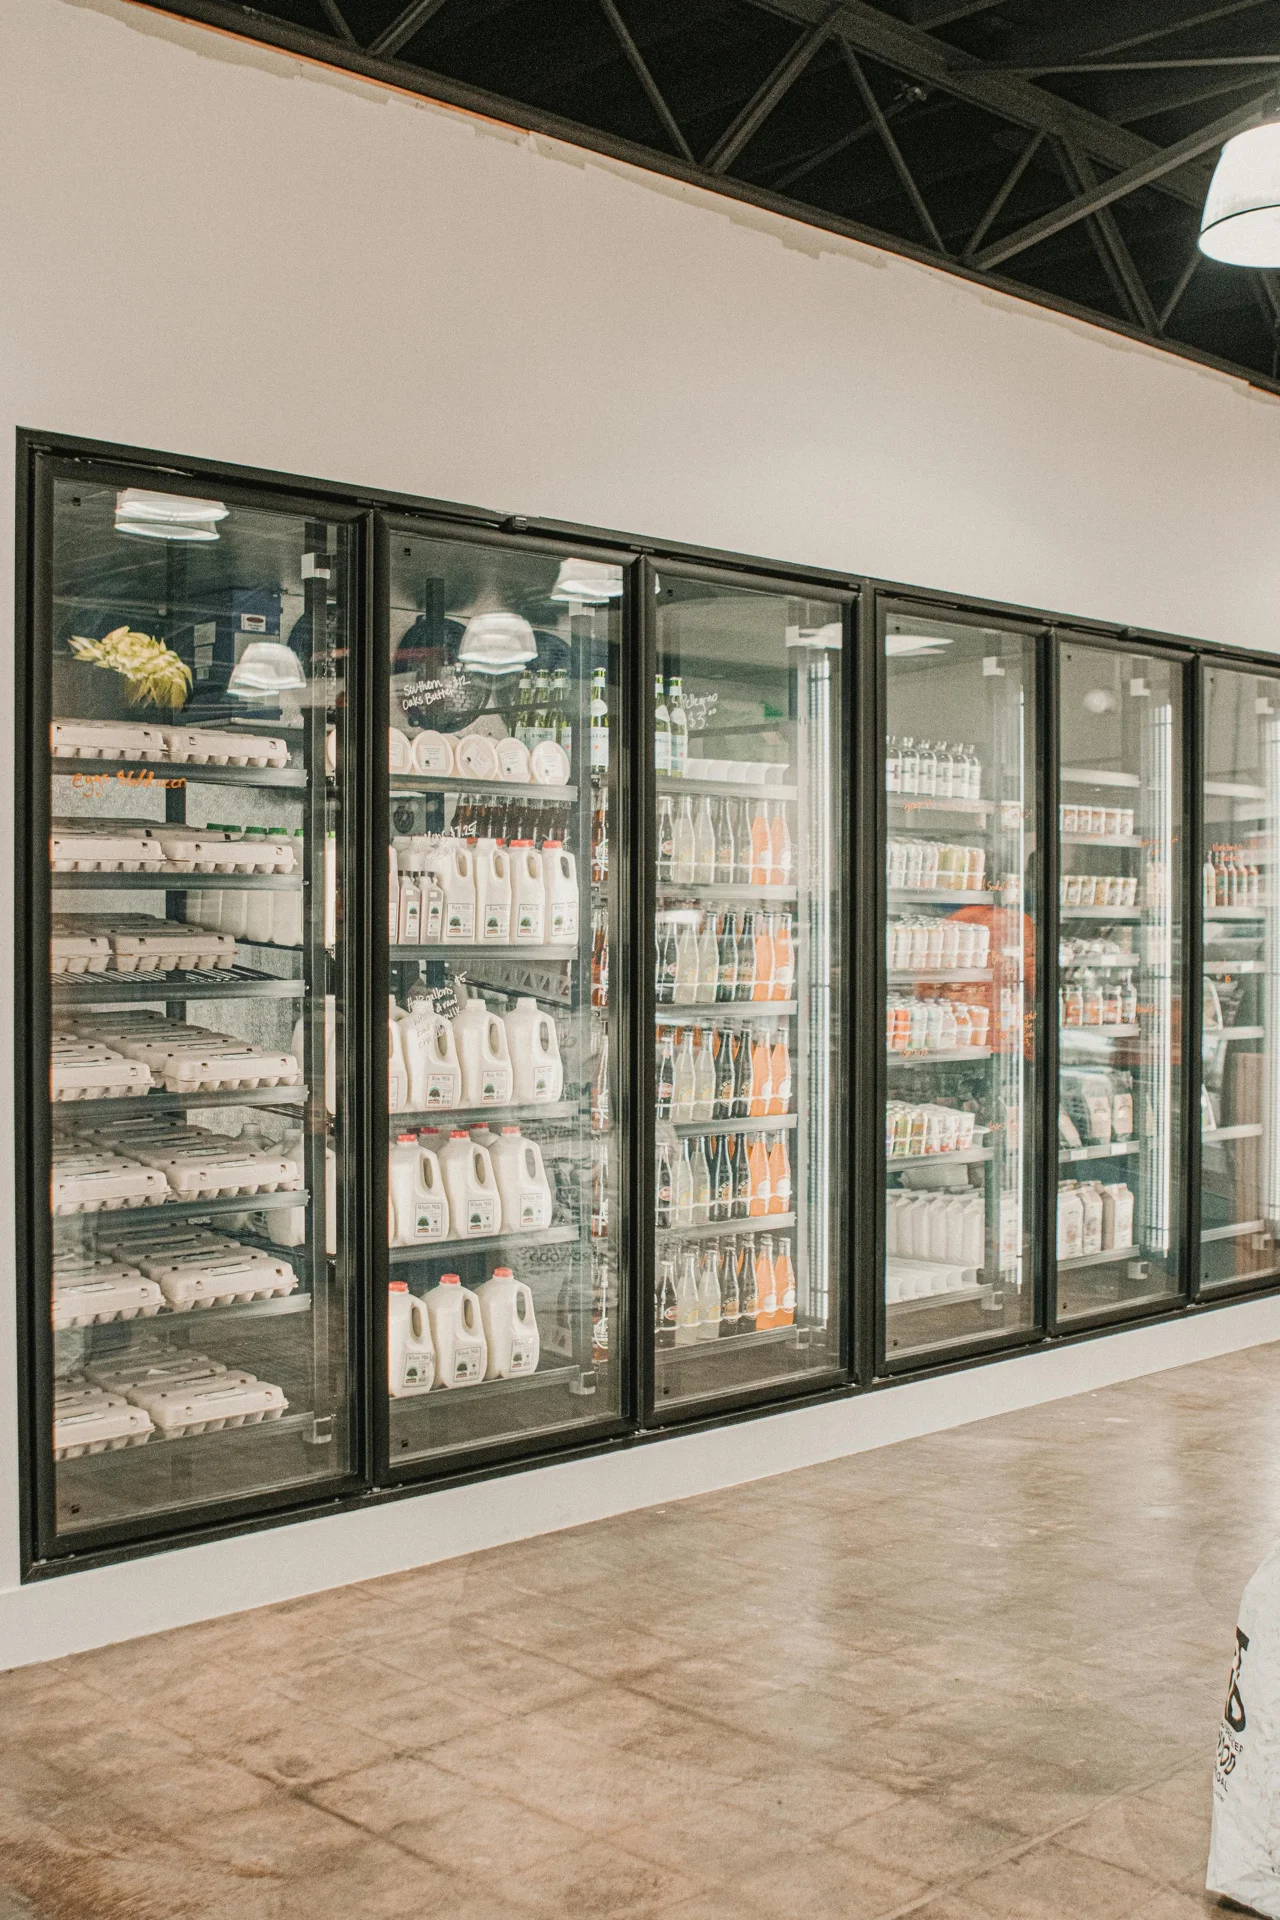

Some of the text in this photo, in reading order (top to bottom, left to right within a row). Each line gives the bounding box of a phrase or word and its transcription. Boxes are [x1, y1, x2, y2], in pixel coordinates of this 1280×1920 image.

[403, 679, 443, 696] Southern
[402, 688, 453, 711] Oaks Butter
